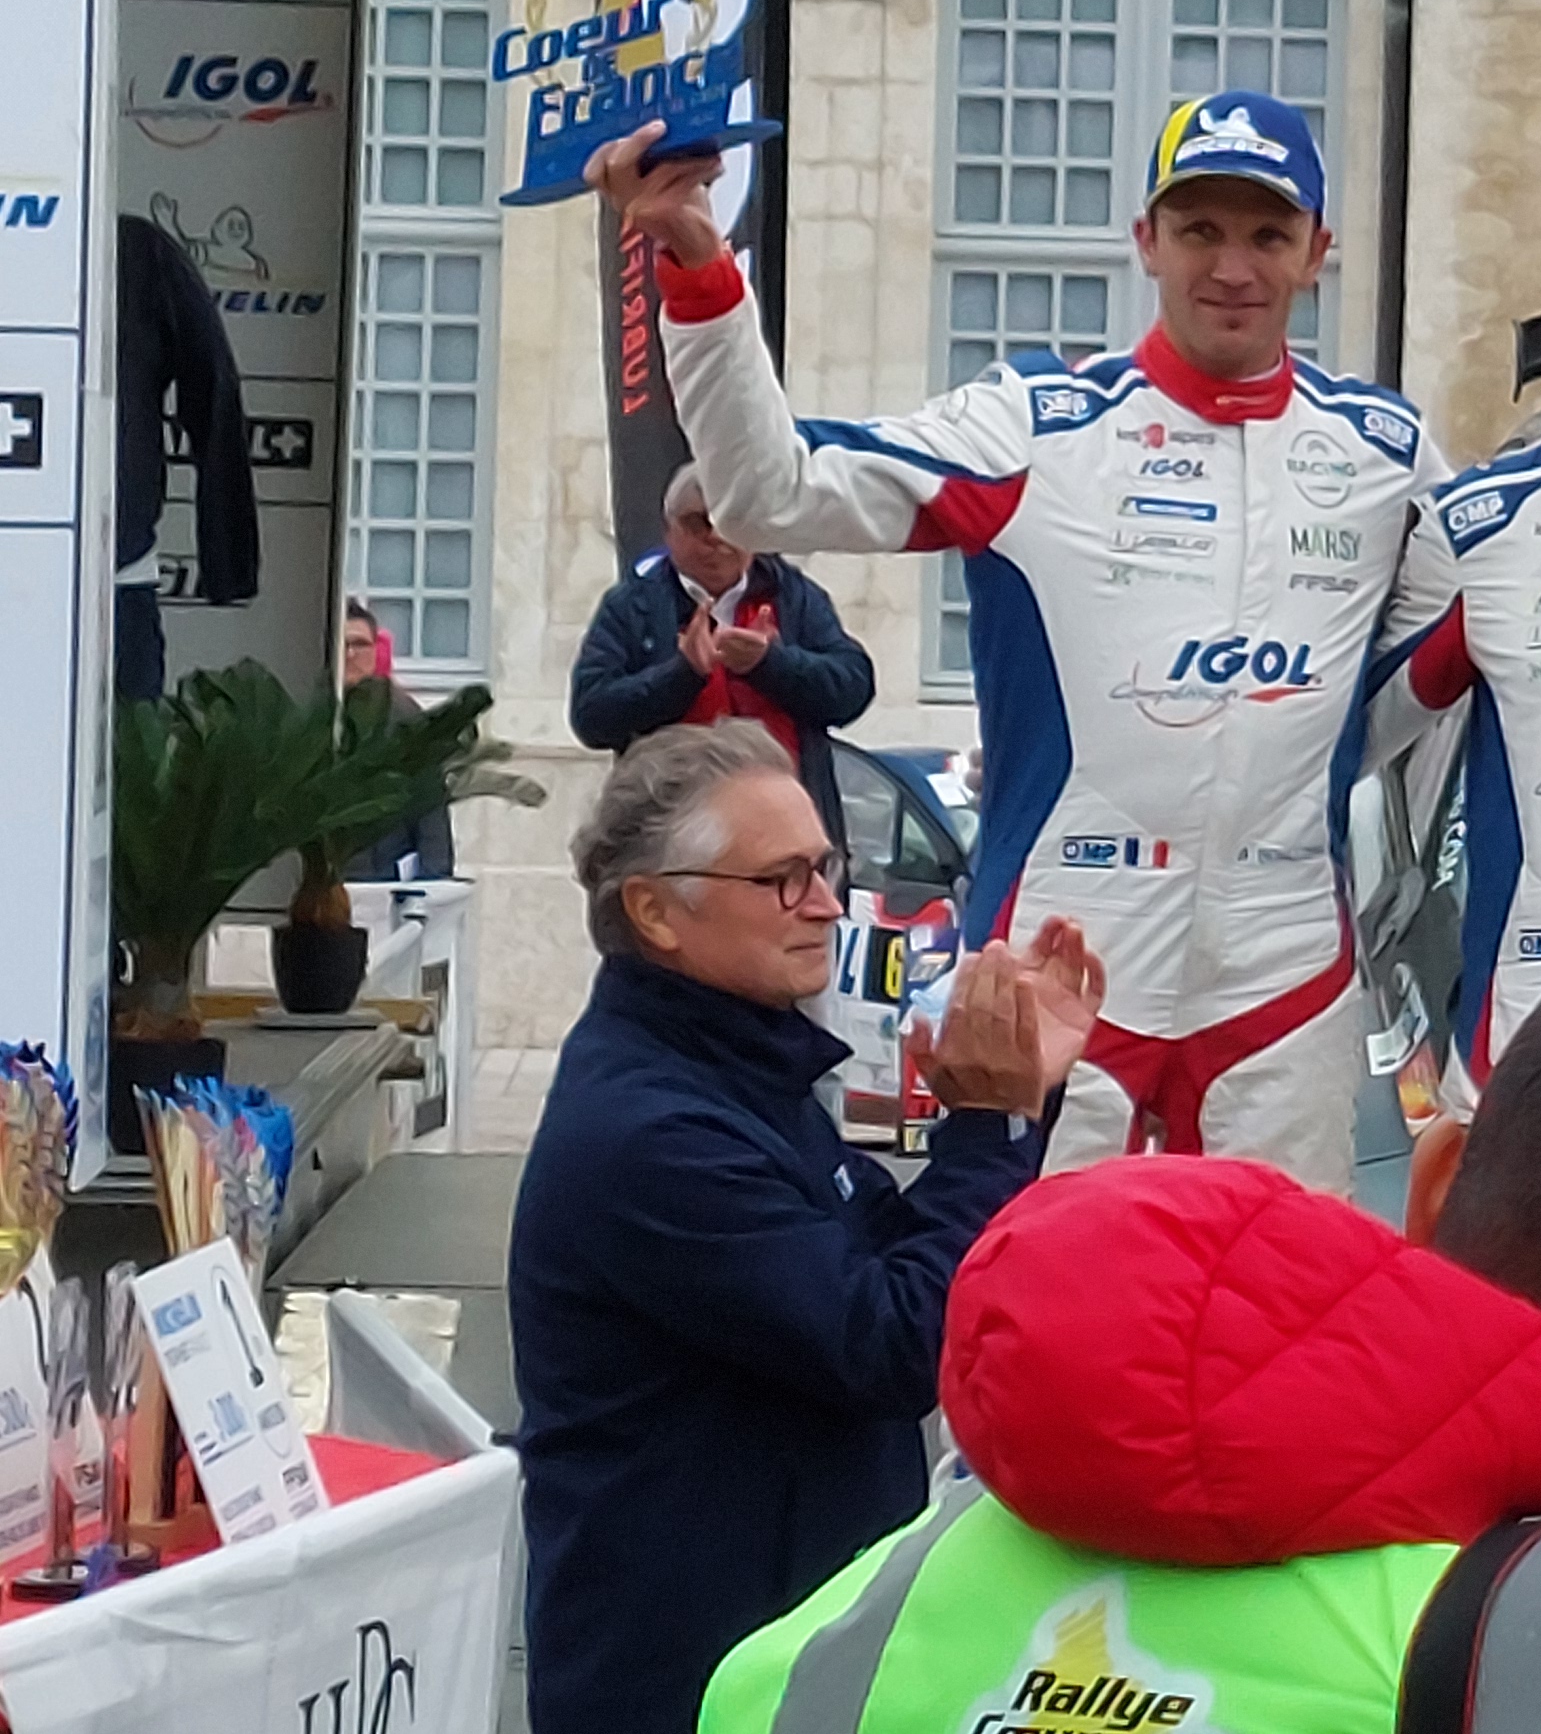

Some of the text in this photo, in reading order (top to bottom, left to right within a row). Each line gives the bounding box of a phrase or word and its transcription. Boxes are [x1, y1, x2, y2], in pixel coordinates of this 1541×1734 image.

[1447, 491, 1505, 532] OMP
[1288, 527, 1362, 563] MARSY
[1009, 1668, 1196, 1732] Rallye
